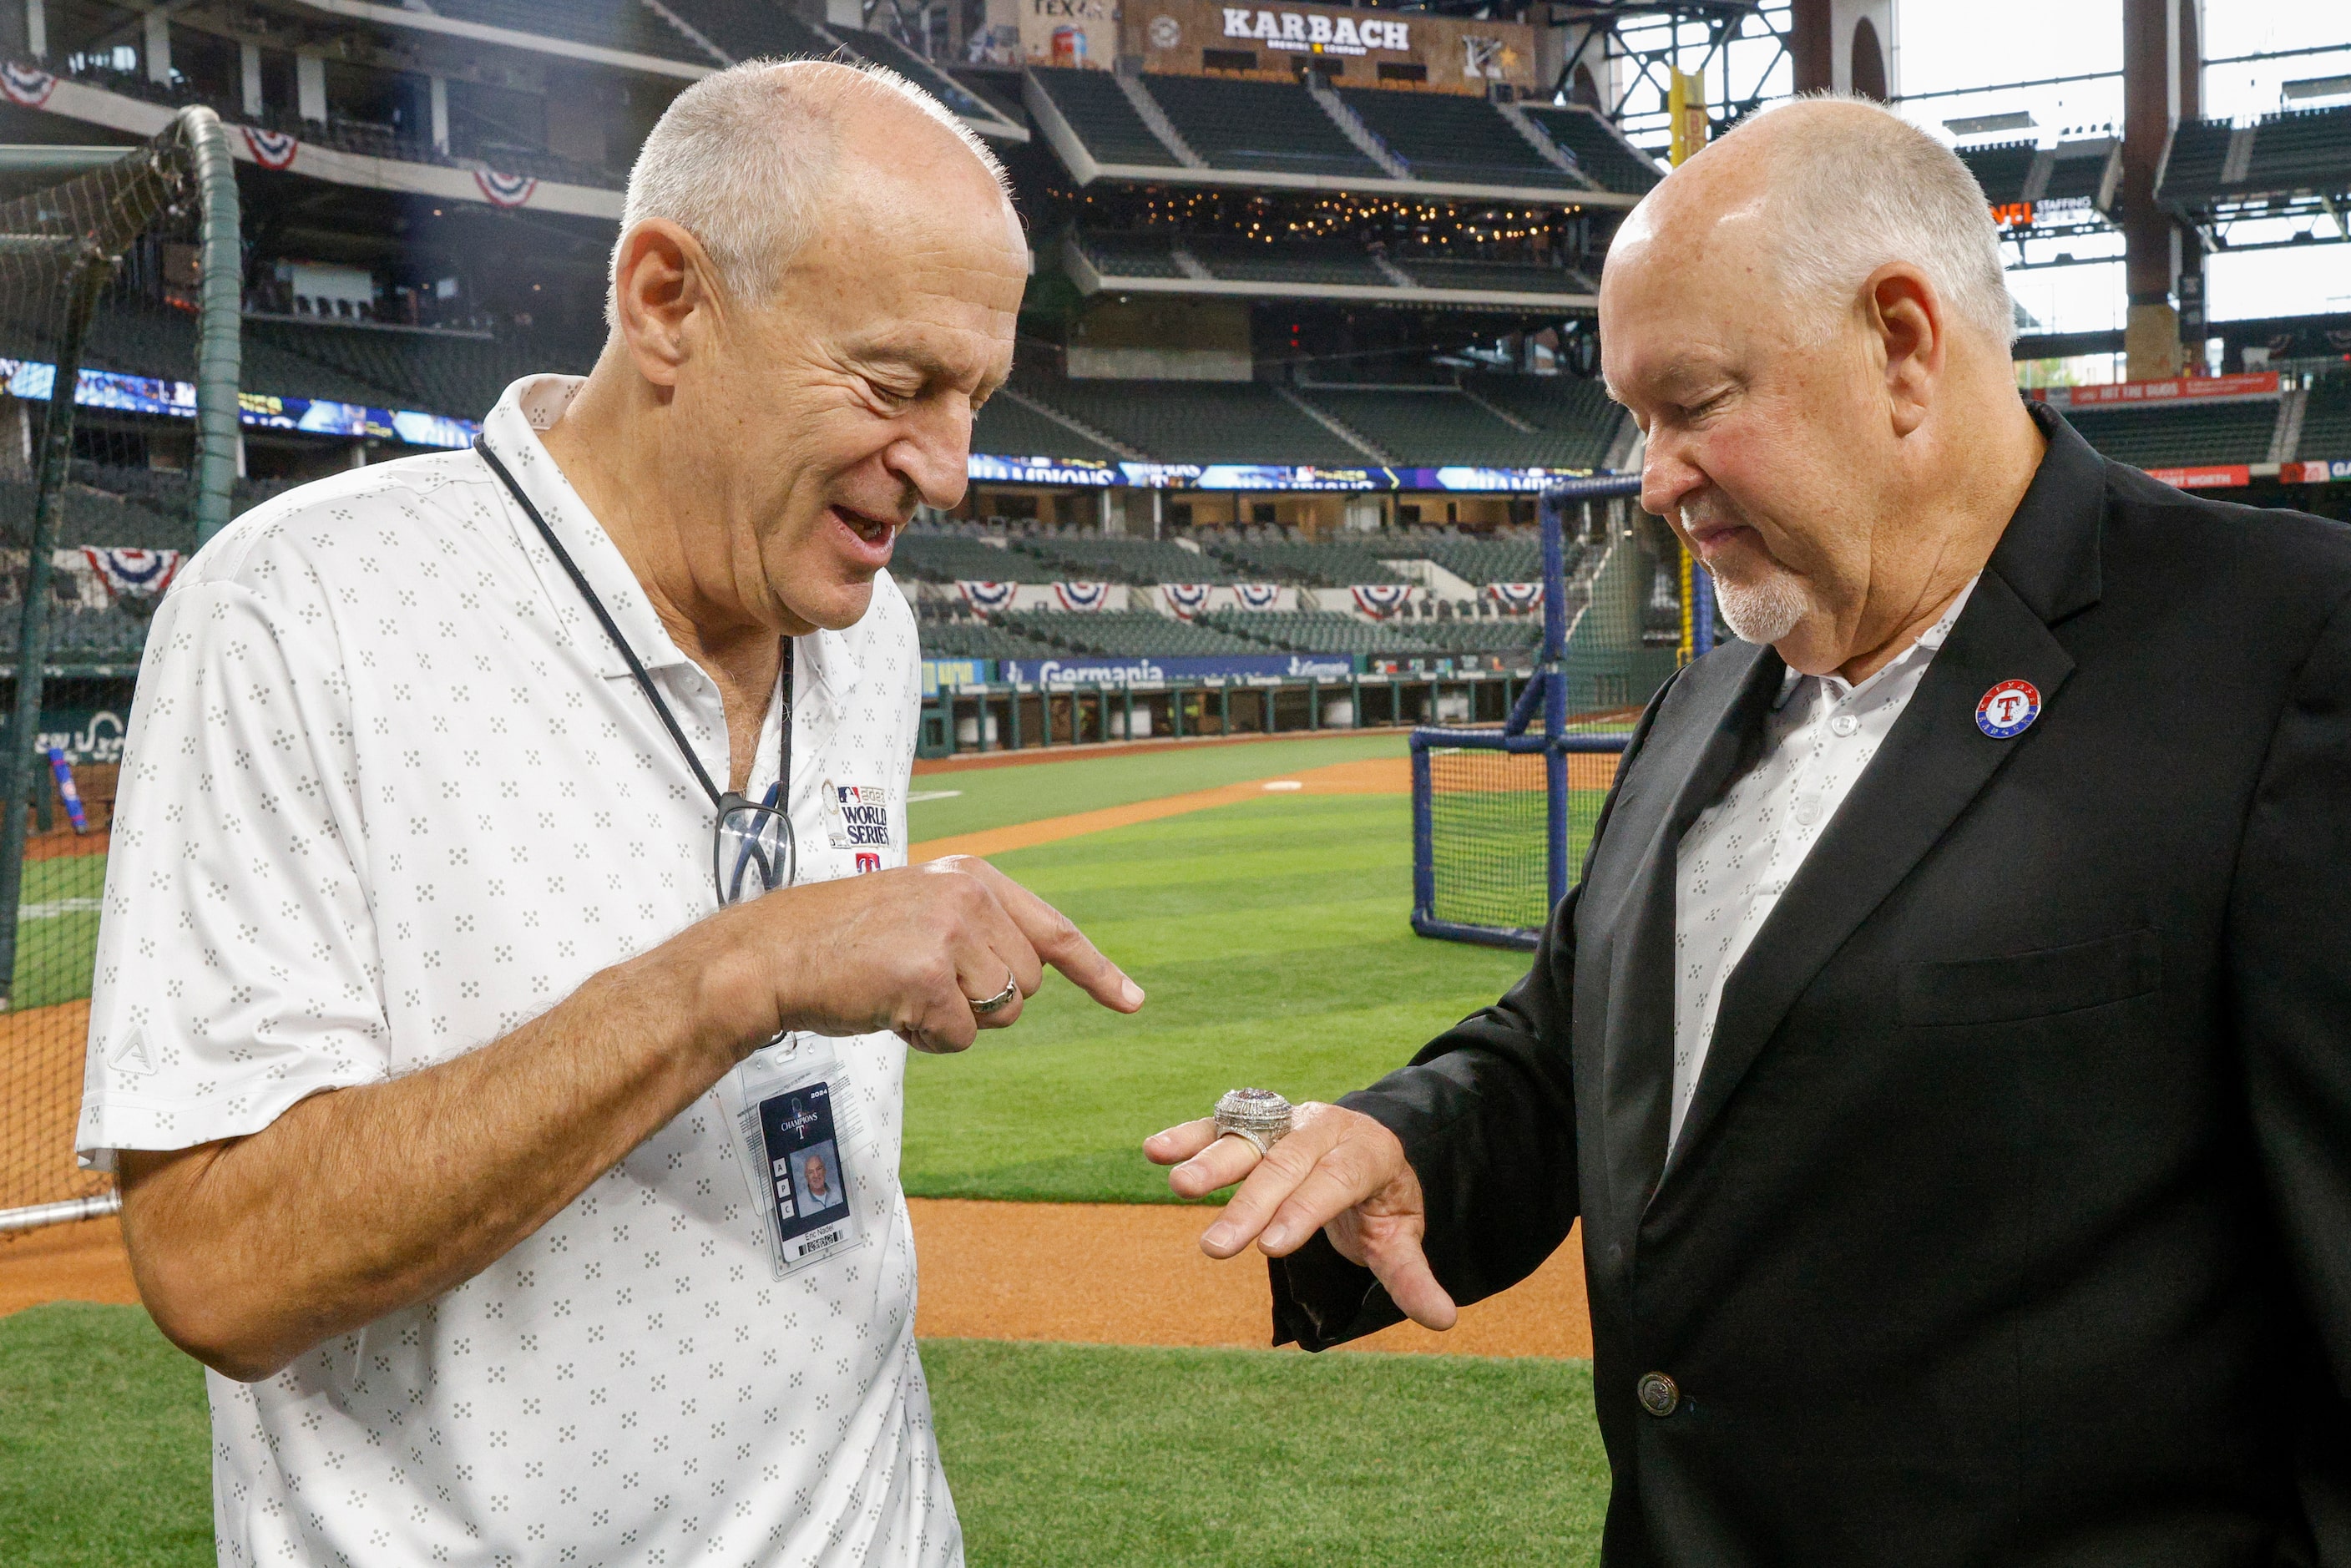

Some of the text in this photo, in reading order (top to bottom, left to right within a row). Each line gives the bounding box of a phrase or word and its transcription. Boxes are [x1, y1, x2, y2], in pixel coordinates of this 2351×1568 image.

[1222, 8, 1410, 51] KARBACH
[1323, 43, 1368, 56] COMPANY
[1039, 658, 1164, 683] Germania
[1996, 695, 2021, 722] T
[842, 805, 887, 826] WORLD
[847, 825, 890, 846] SERIES
[810, 1089, 828, 1099] 2024
[781, 1111, 818, 1132] CHAMPIONS
[796, 1124, 805, 1140] T
[804, 1222, 835, 1241] Eric Nadel
